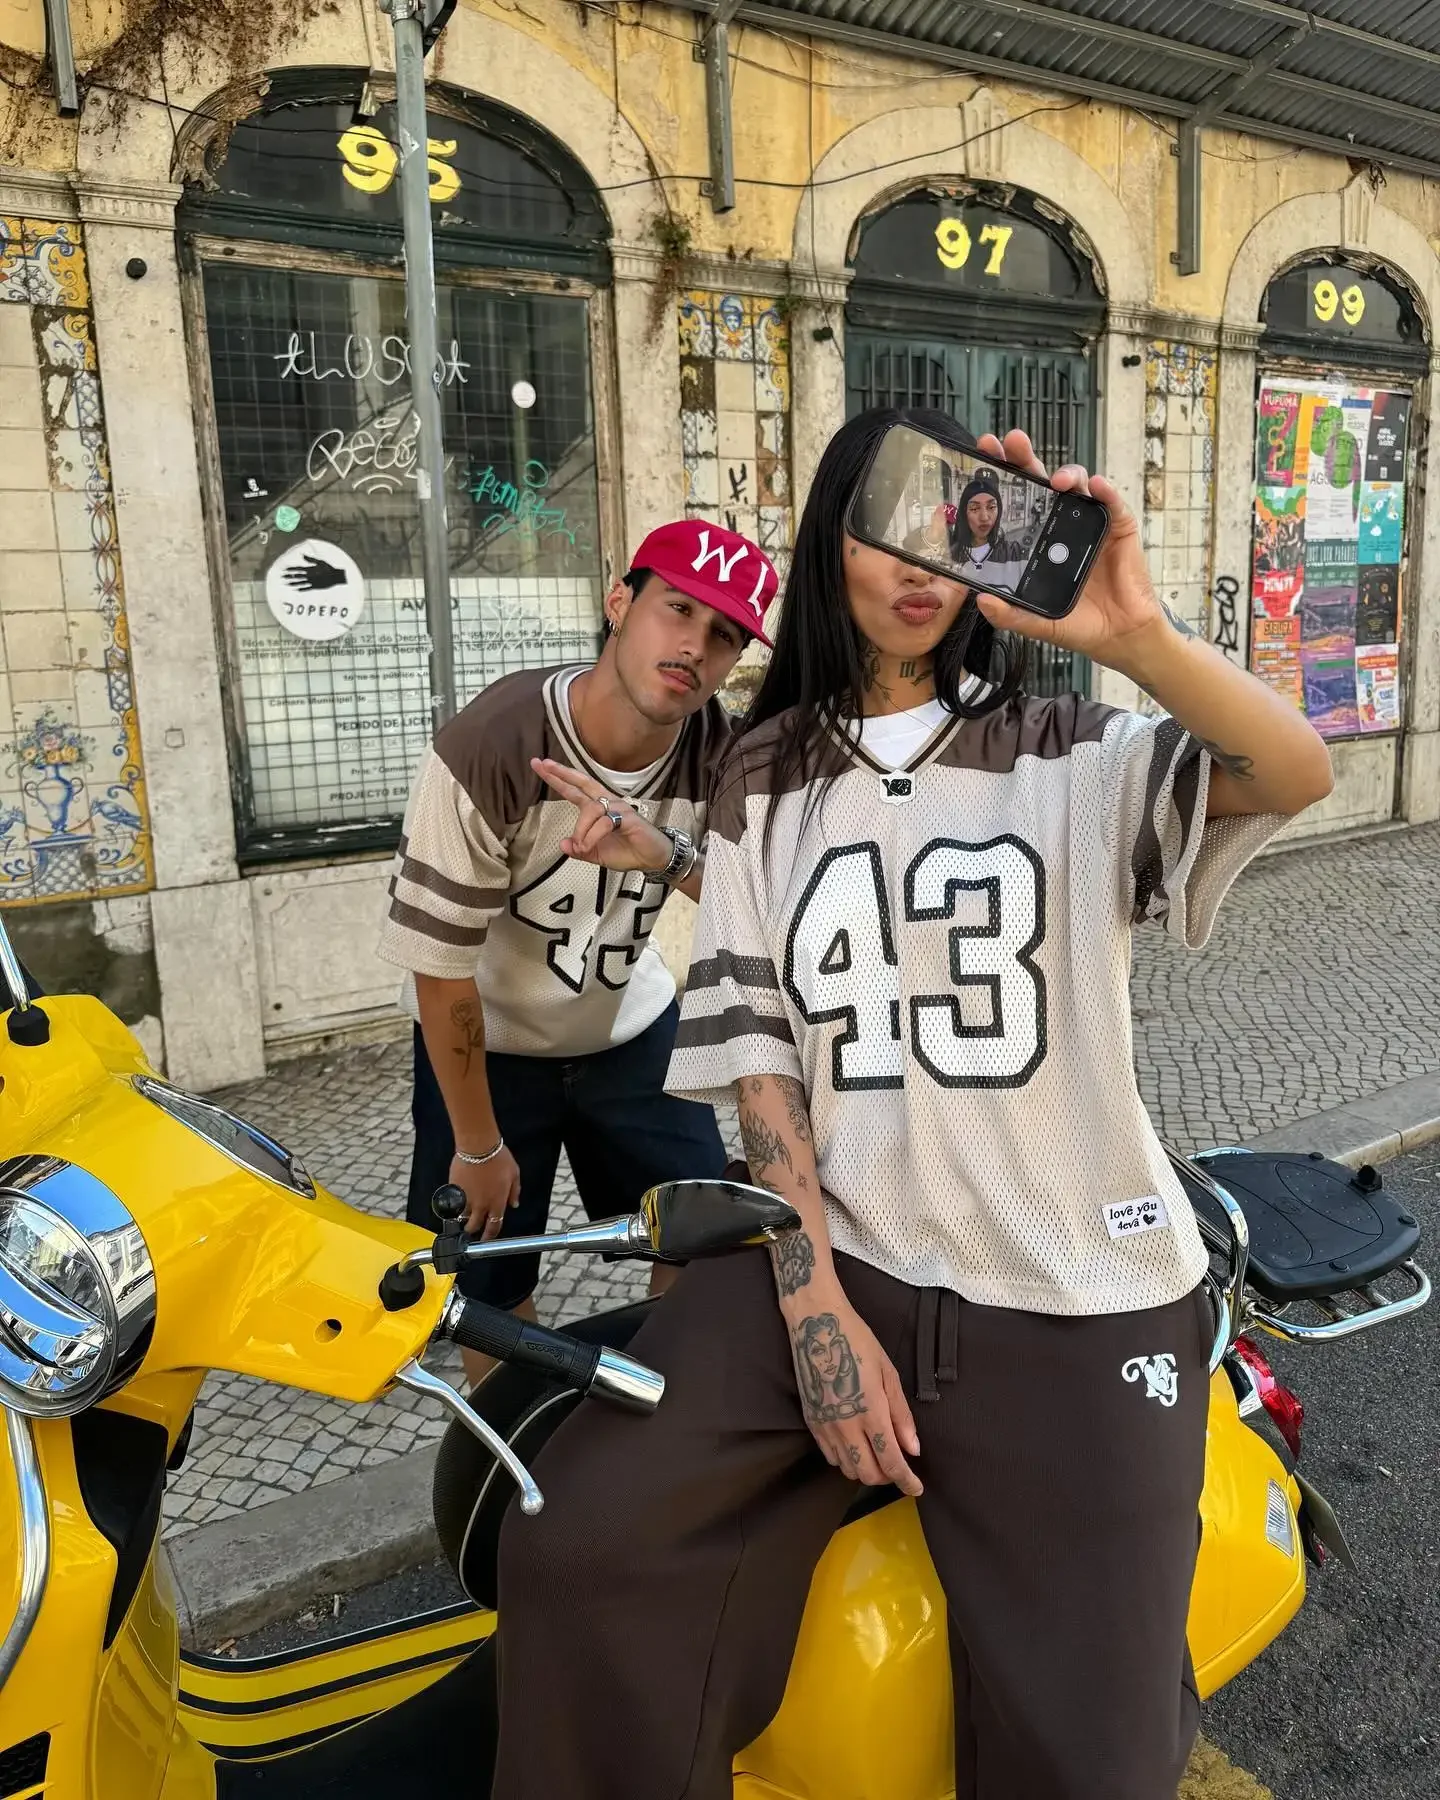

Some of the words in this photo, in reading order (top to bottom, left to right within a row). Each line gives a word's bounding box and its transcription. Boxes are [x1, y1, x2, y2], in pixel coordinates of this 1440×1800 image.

[337, 126, 461, 202] 95
[934, 217, 1014, 275] 97
[1313, 279, 1366, 325] 99
[509, 850, 671, 994] 43
[783, 833, 1046, 1091] 43
[1109, 1205, 1134, 1220] love
[1136, 1201, 1158, 1217] you
